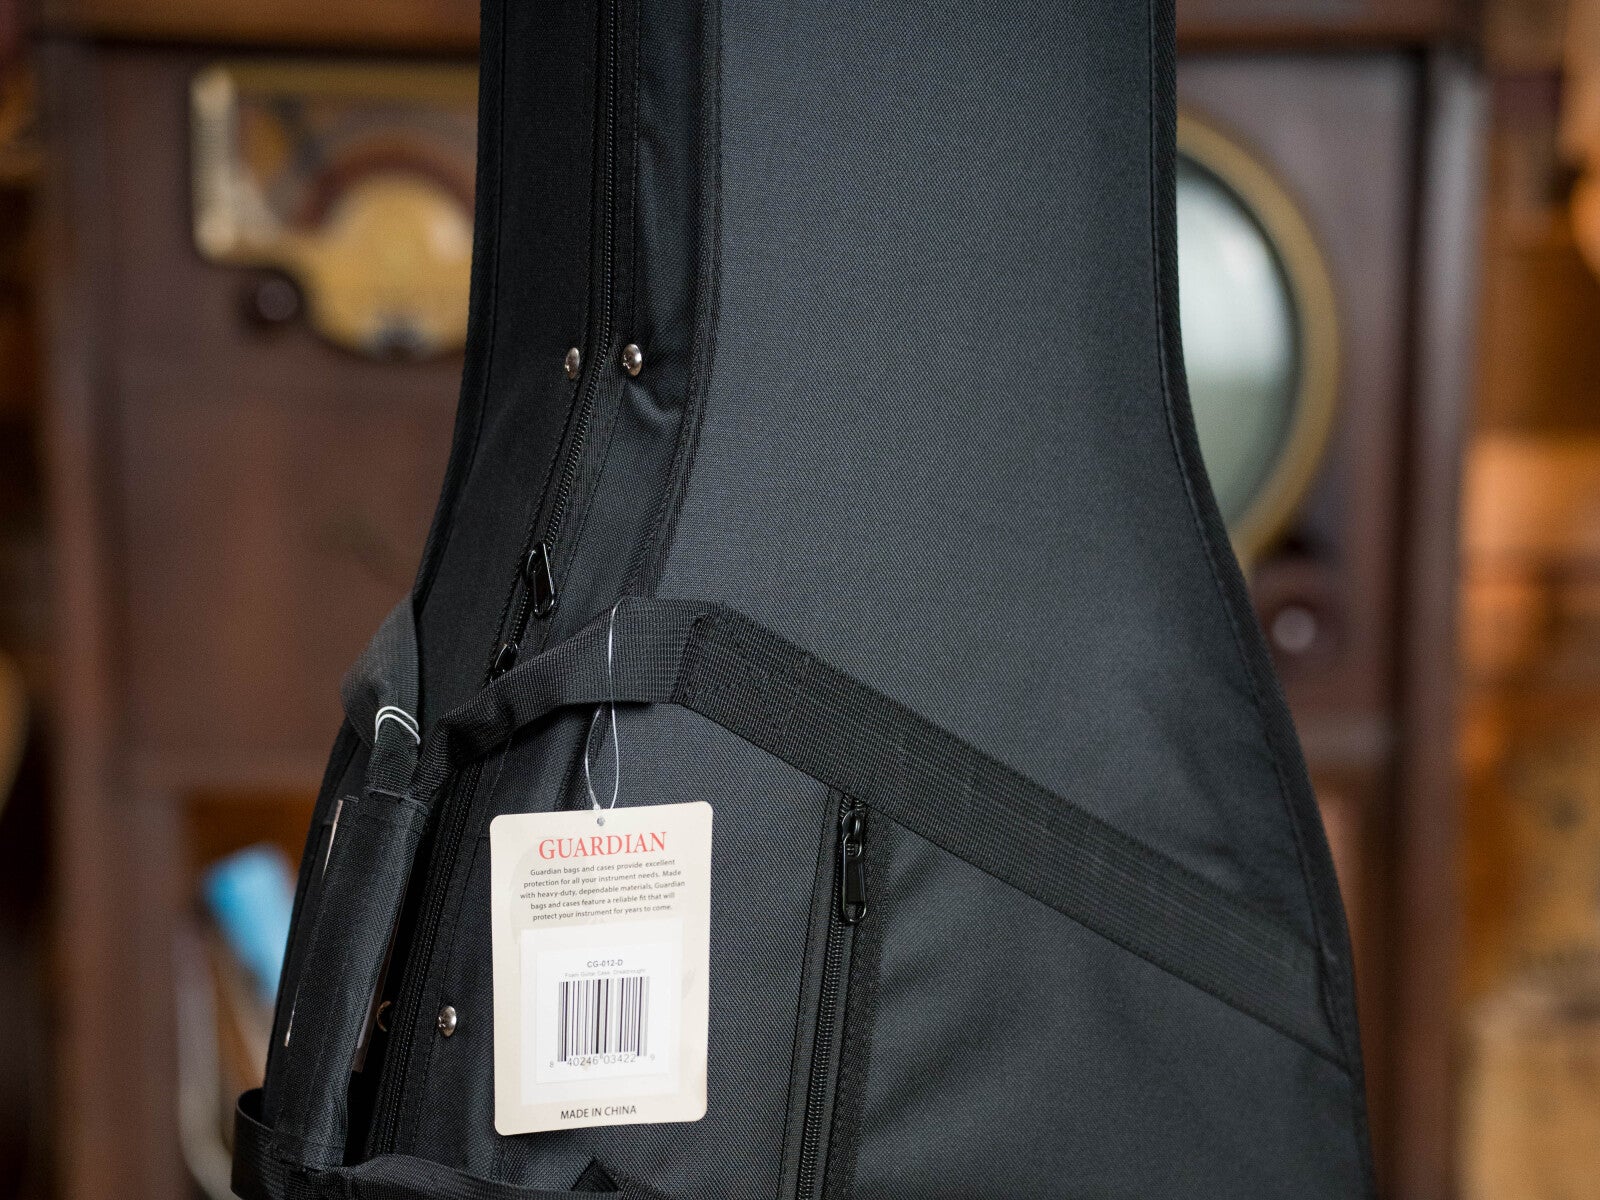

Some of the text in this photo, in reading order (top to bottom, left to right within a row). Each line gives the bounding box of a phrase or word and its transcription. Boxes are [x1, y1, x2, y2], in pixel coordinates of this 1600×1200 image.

[539, 831, 667, 860] GUARDIAN
[530, 867, 562, 876] Guardian
[563, 866, 580, 874] bags
[616, 862, 643, 871] provide
[645, 859, 675, 867] excellent
[523, 879, 559, 889] protection
[581, 877, 597, 885] your
[599, 874, 636, 882] instrument
[638, 871, 660, 879] needs.
[662, 869, 682, 877] Made
[520, 880, 686, 899] with heavy-duty, dependable materials, Guardian
[530, 902, 547, 910] bags
[581, 897, 606, 906] feature
[613, 894, 638, 903] reliable
[639, 893, 647, 901] fit
[647, 892, 662, 900] that
[663, 891, 676, 899] will
[532, 912, 557, 922] protect
[558, 912, 574, 920] your
[575, 908, 612, 917] instrument
[625, 906, 643, 915] years
[652, 904, 673, 912] come.
[586, 958, 624, 968] CG-012-D
[567, 1056, 600, 1067] 40246
[603, 1053, 637, 1064] 03422
[649, 1053, 656, 1061] 9
[560, 1105, 637, 1120] MADE IN CHINA
